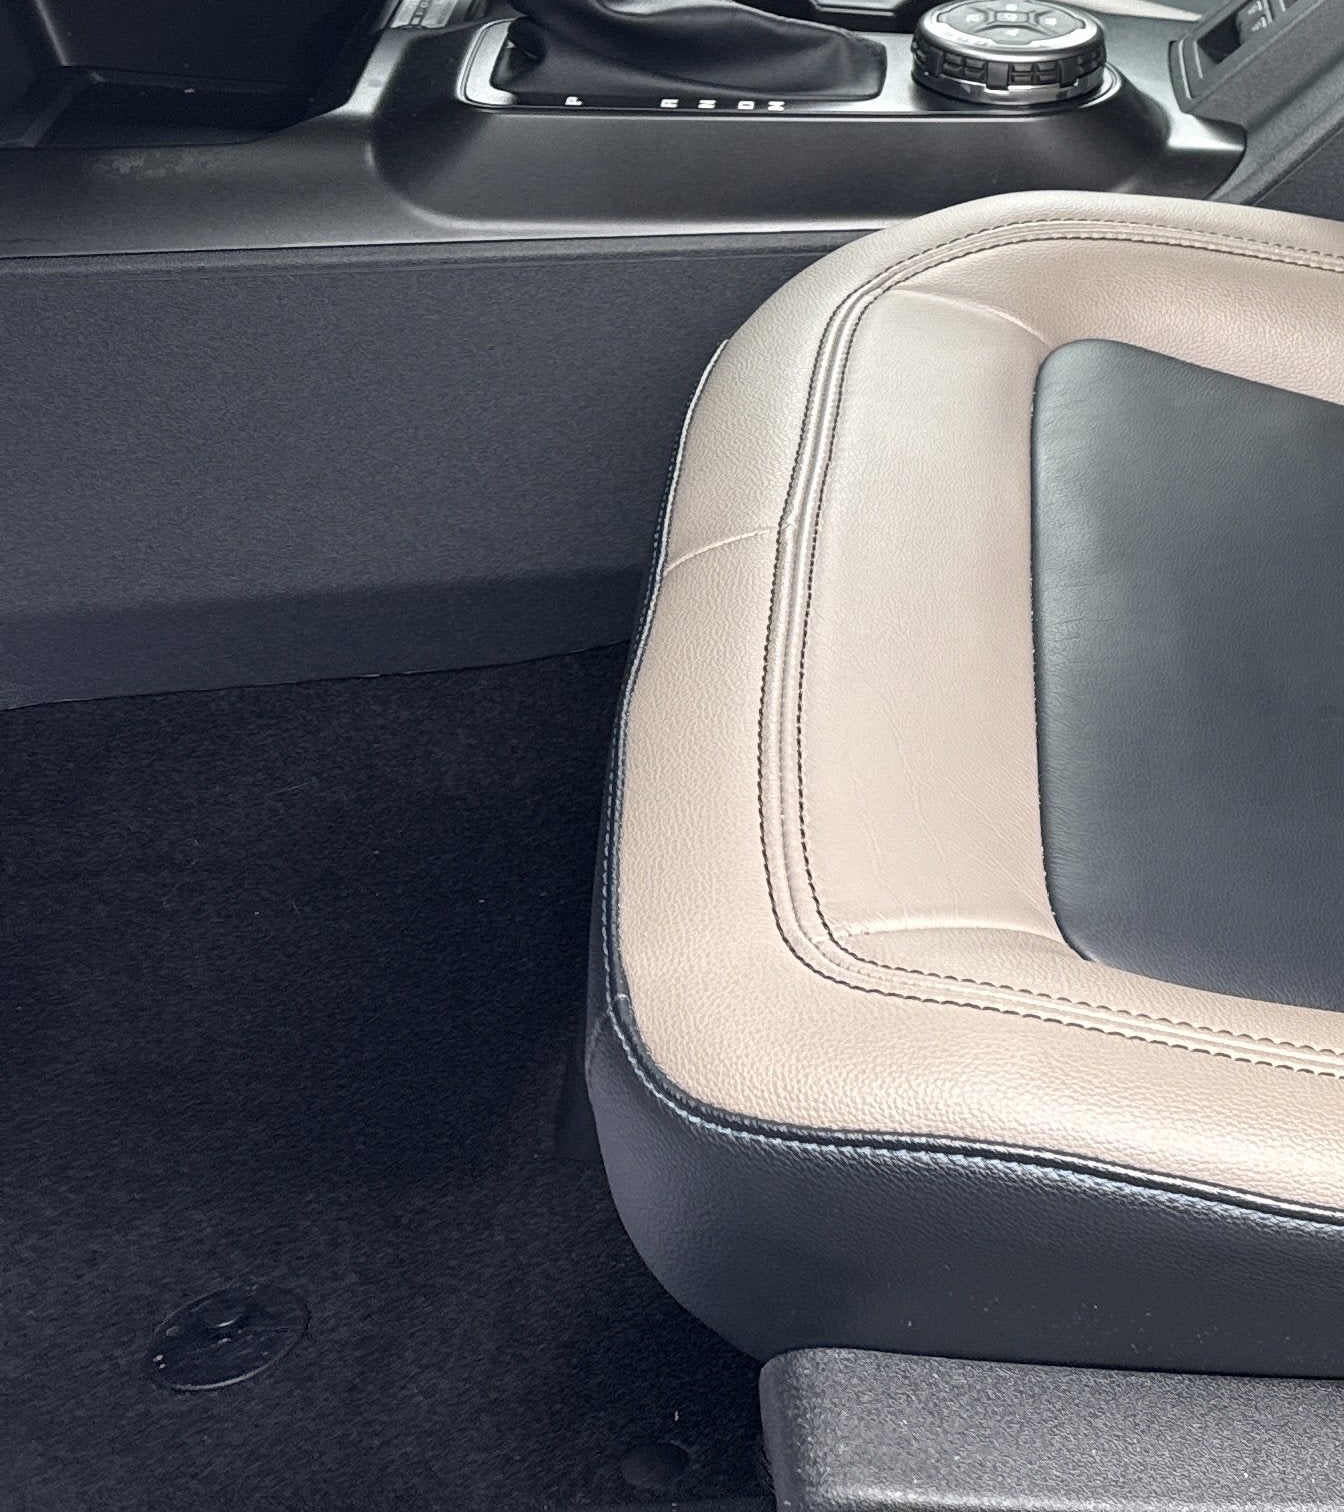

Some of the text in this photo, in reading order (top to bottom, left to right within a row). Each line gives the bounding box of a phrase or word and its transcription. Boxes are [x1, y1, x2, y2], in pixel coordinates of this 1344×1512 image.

[564, 96, 785, 111] P R N D M
